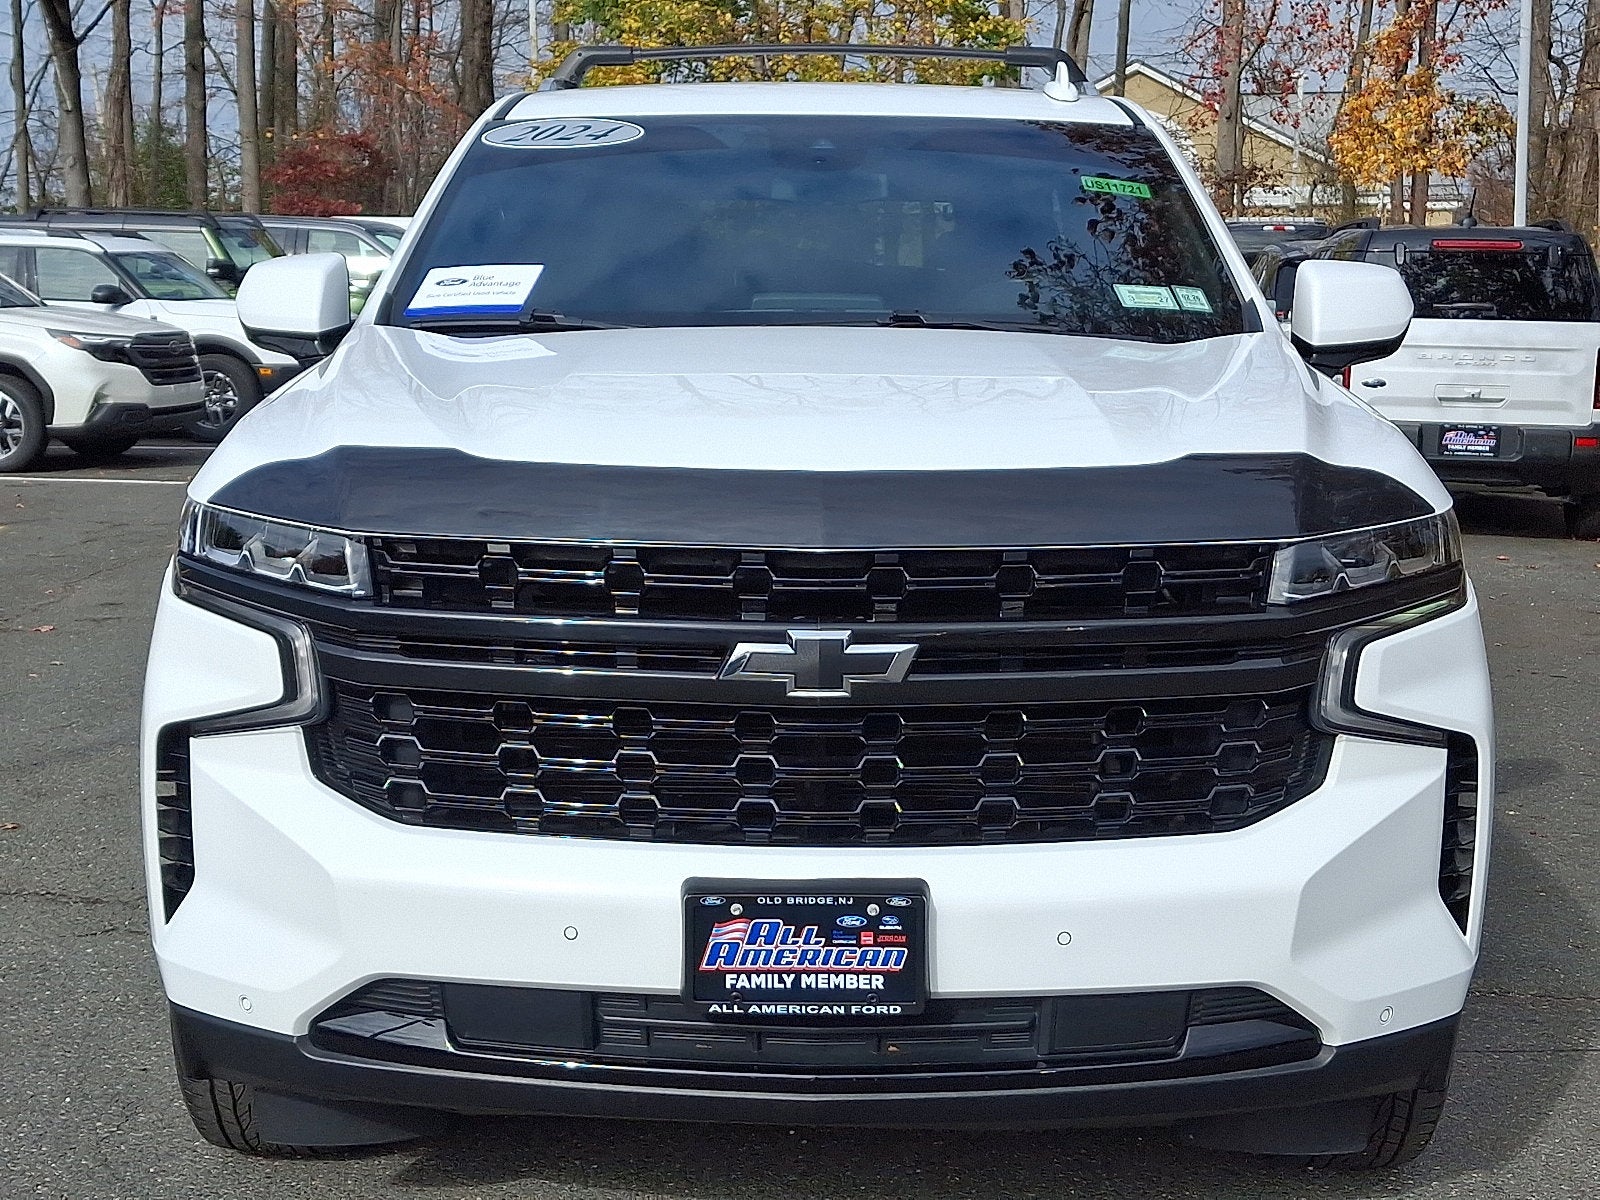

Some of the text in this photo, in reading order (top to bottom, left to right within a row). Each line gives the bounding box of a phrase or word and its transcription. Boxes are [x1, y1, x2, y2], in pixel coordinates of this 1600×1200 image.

[502, 124, 624, 143] 2024
[1085, 179, 1143, 195] US11721
[1417, 353, 1536, 363] BRONCO
[757, 896, 781, 905] OLD
[746, 918, 826, 946] ALL
[701, 940, 908, 970] AMERICAN
[725, 973, 884, 989] FAMILY MEMBER
[708, 1004, 902, 1015] ALL AMERICAN FORD
